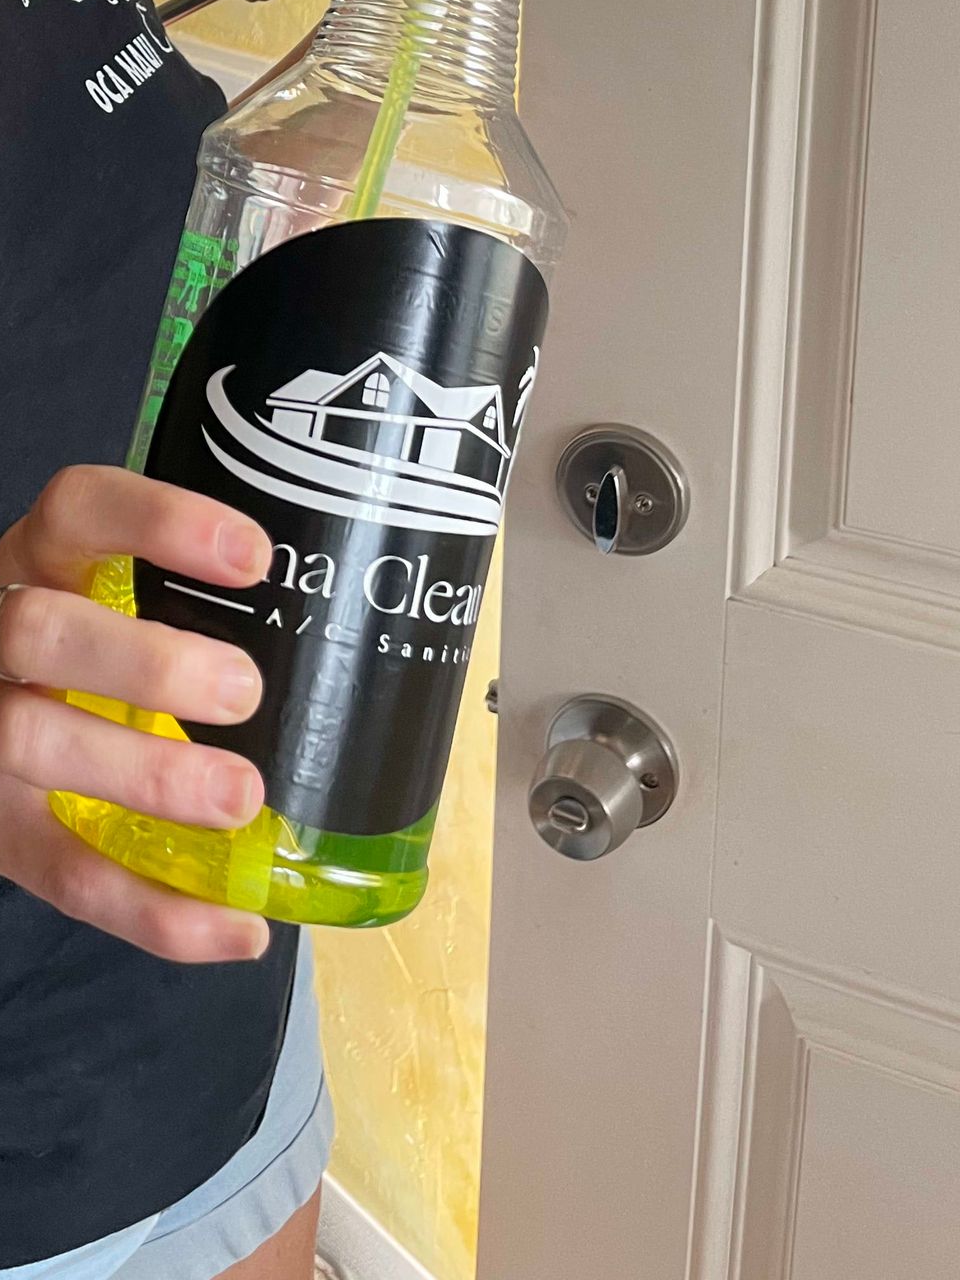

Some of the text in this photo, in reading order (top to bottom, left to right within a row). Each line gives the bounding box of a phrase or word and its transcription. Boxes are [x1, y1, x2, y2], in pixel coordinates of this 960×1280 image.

[85, 33, 163, 113] OCA MAUI
[377, 633, 470, 664] Saniti
